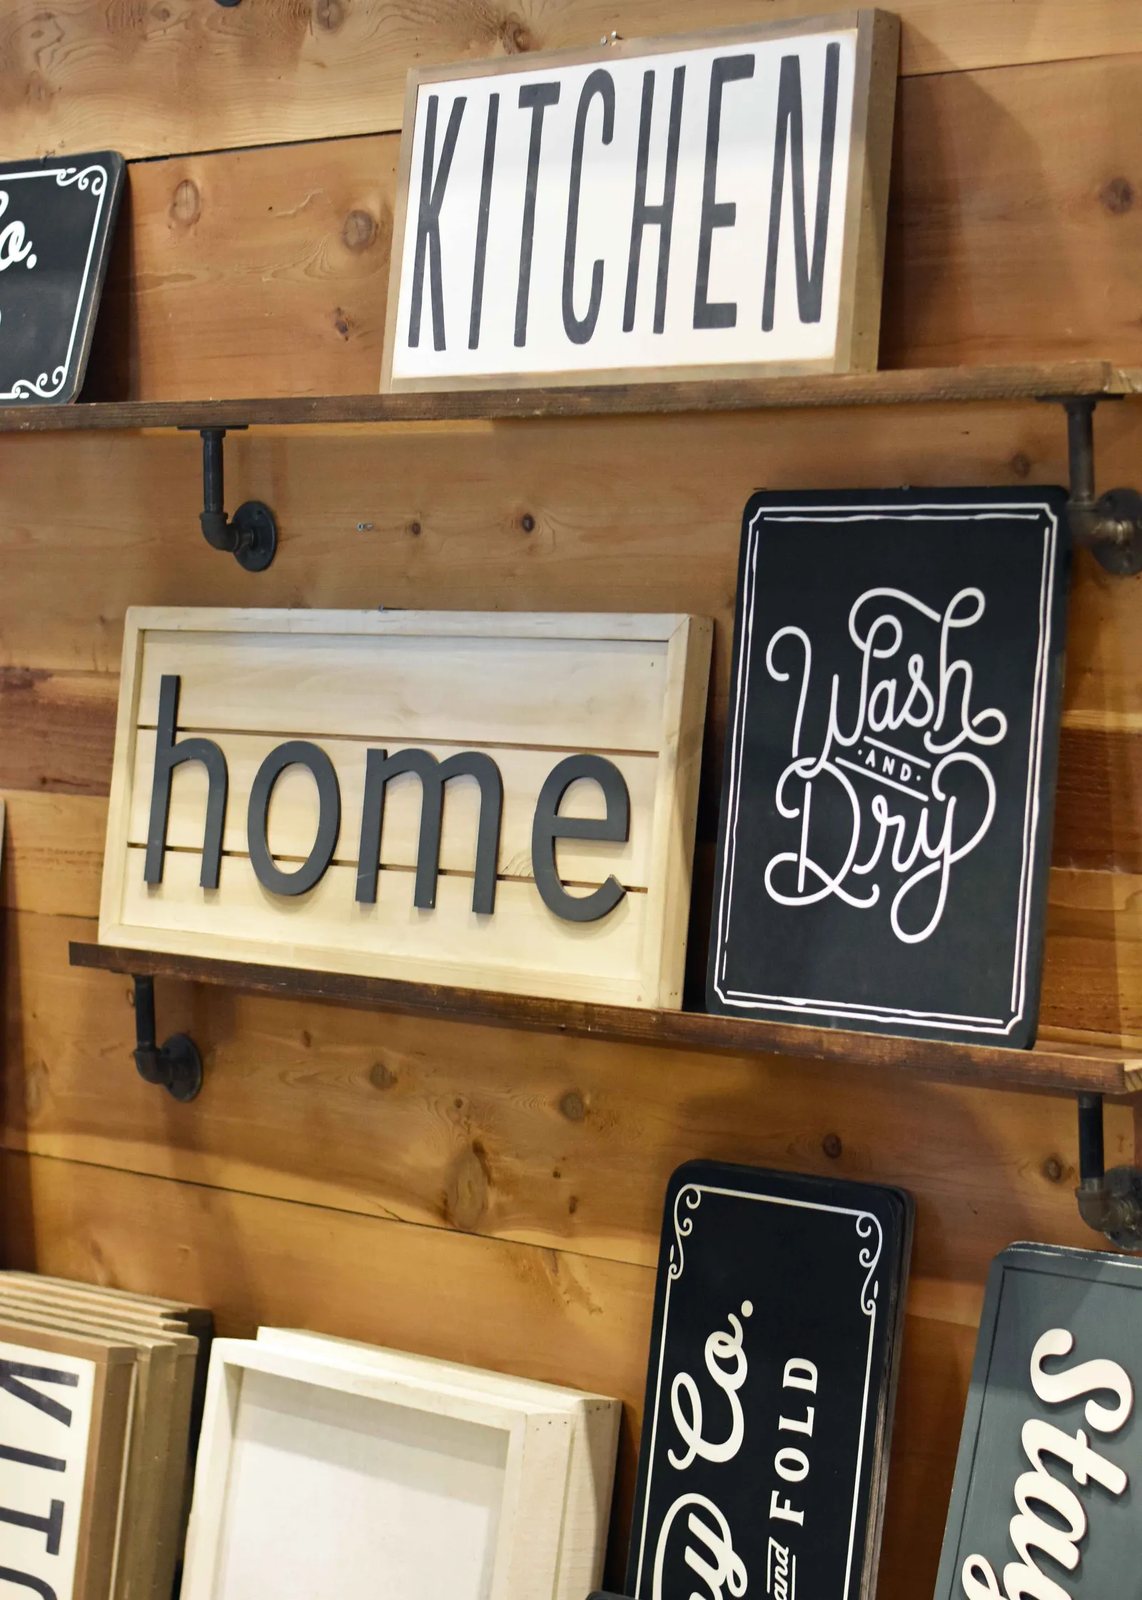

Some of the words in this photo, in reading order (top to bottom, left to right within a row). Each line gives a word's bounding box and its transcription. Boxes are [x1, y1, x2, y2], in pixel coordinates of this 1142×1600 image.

[408, 42, 840, 351] KITCHEN
[766, 587, 1007, 778] Wash
[143, 674, 630, 922] home
[764, 752, 996, 944] Dry
[668, 1299, 754, 1470] Co.
[768, 1356, 819, 1527] FOLD
